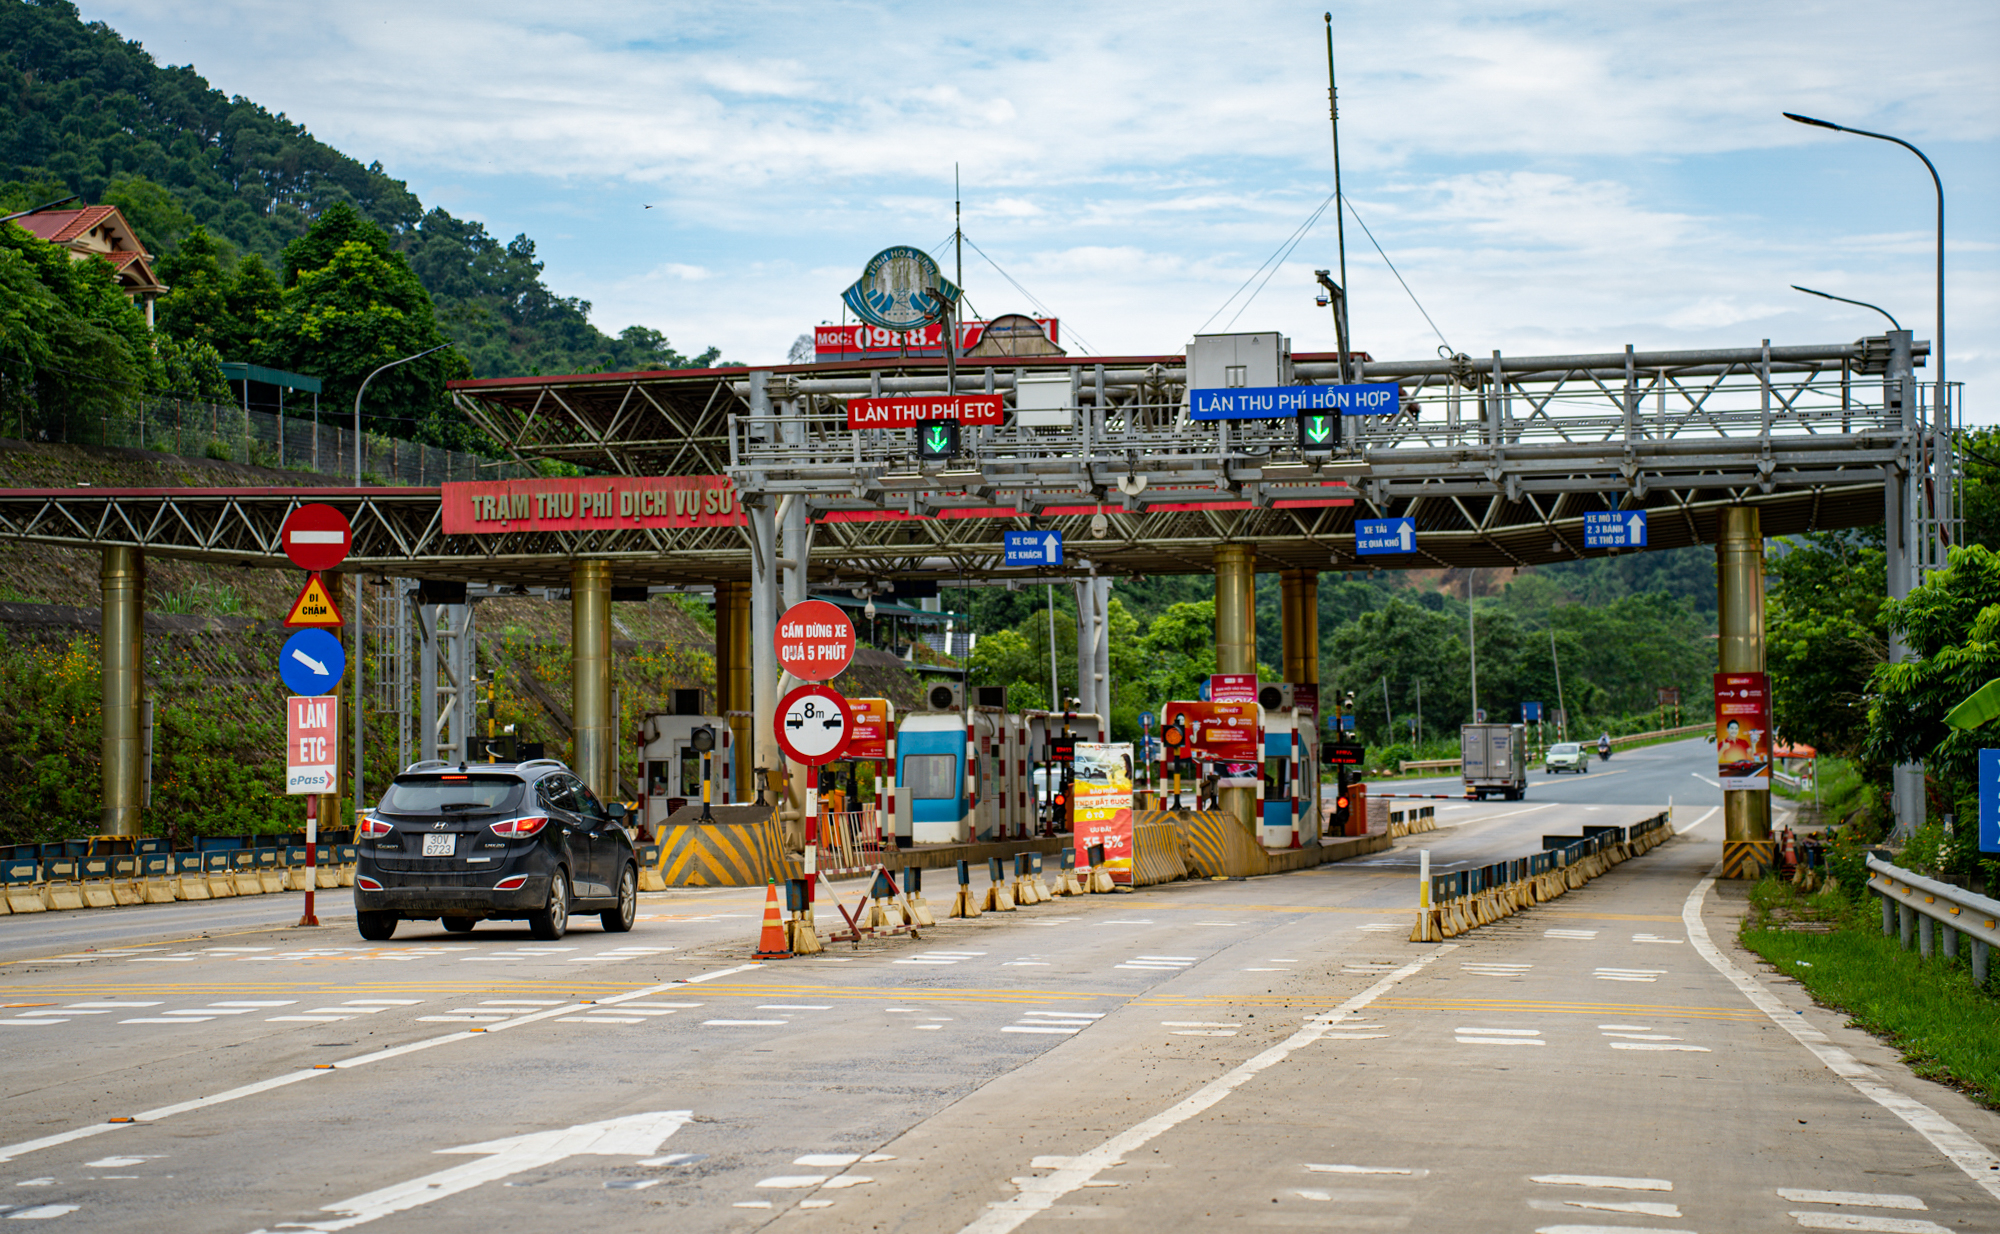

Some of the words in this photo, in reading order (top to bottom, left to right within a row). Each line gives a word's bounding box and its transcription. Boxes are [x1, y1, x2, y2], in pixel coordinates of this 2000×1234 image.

[817, 331, 853, 346] MQC:
[1198, 393, 1234, 412] LÀN
[1238, 394, 1273, 411] THU
[1278, 389, 1306, 410] PHÍ
[1312, 387, 1350, 408] HỖN
[1355, 390, 1391, 410] HỢP
[854, 401, 889, 422] LÀN
[892, 404, 927, 420] THU
[931, 399, 960, 419] PHÍ
[964, 402, 996, 418] ETC
[471, 494, 530, 526] TRẠM
[535, 492, 574, 519] THU
[579, 486, 614, 518] PHÍ
[619, 490, 668, 523] DỊCH
[673, 489, 701, 522] VỤ
[705, 477, 735, 515] SỬ
[1586, 514, 1597, 523] XE
[1611, 512, 1622, 523] TÔ
[1363, 525, 1374, 534] XE
[1375, 523, 1387, 534] TẢI
[1602, 524, 1624, 534] BÁNH
[1011, 537, 1022, 546] XE
[1022, 537, 1038, 546] CON
[1357, 540, 1368, 548] XE
[1368, 538, 1383, 548] QUÁ
[1587, 536, 1598, 545] XE
[1598, 534, 1613, 545] THÔ
[1007, 551, 1017, 560] XE
[1018, 549, 1043, 560] KHÁCH
[309, 593, 318, 603] ĐI
[302, 604, 327, 617] CHẬM
[781, 621, 804, 638] CẤM
[805, 621, 832, 638] DỪNG
[834, 624, 847, 638] XE
[781, 642, 805, 662] QUÁ
[807, 645, 815, 660] 5
[817, 642, 847, 660] PHÚT
[298, 698, 327, 729] LÀN
[803, 702, 825, 719] 8m
[300, 736, 327, 763] ETC
[289, 775, 325, 786] ePass
[1086, 811, 1093, 819] Ô
[1093, 810, 1104, 819] TÔ
[430, 835, 449, 845] 30V
[425, 845, 451, 855] 6723
